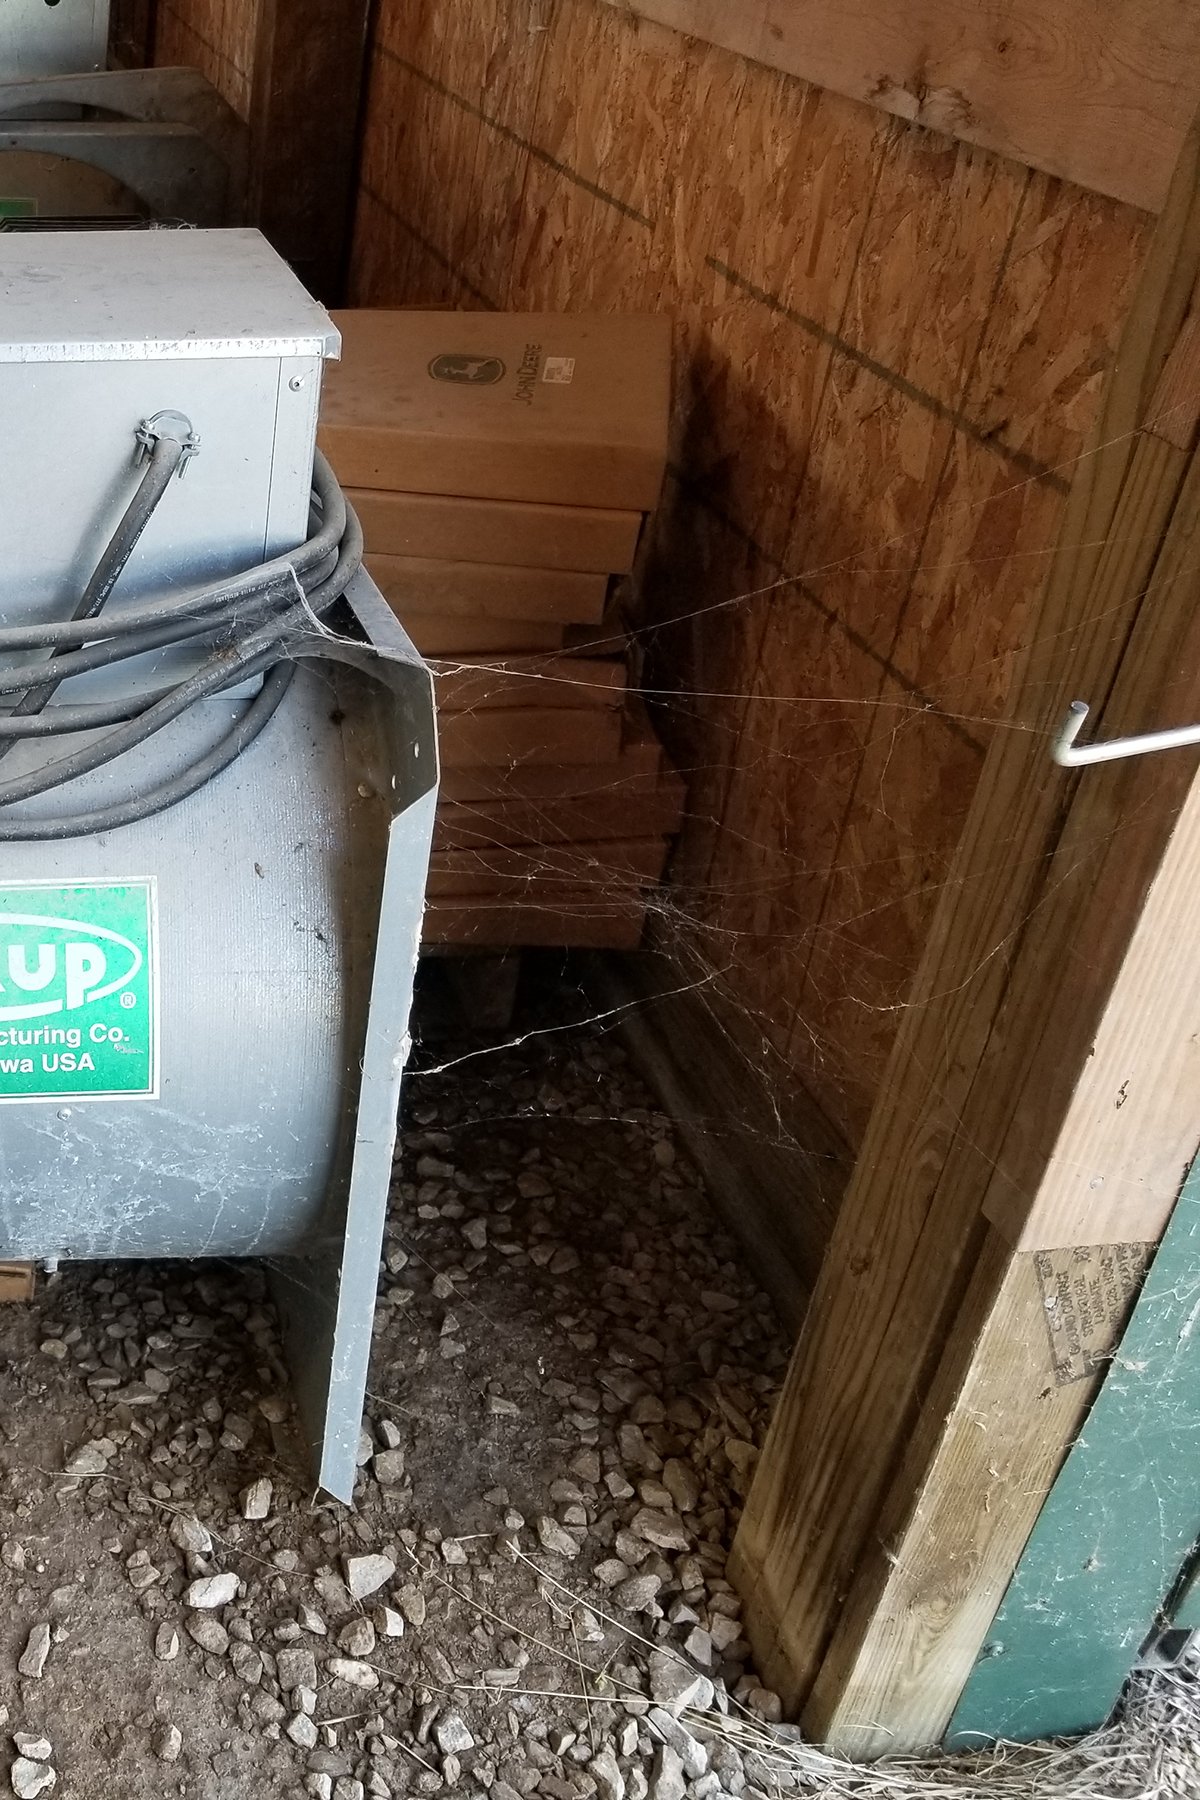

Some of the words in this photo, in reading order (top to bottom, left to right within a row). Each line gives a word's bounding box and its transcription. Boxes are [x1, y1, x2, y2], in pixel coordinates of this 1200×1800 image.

[516, 343, 543, 376] DEERE
[512, 376, 536, 407] JOHN
[89, 1022, 131, 1044] Co.
[42, 1053, 96, 1073] USA
[1055, 1270, 1076, 1315] CONTACT
[1062, 1314, 1083, 1356] GROUND
